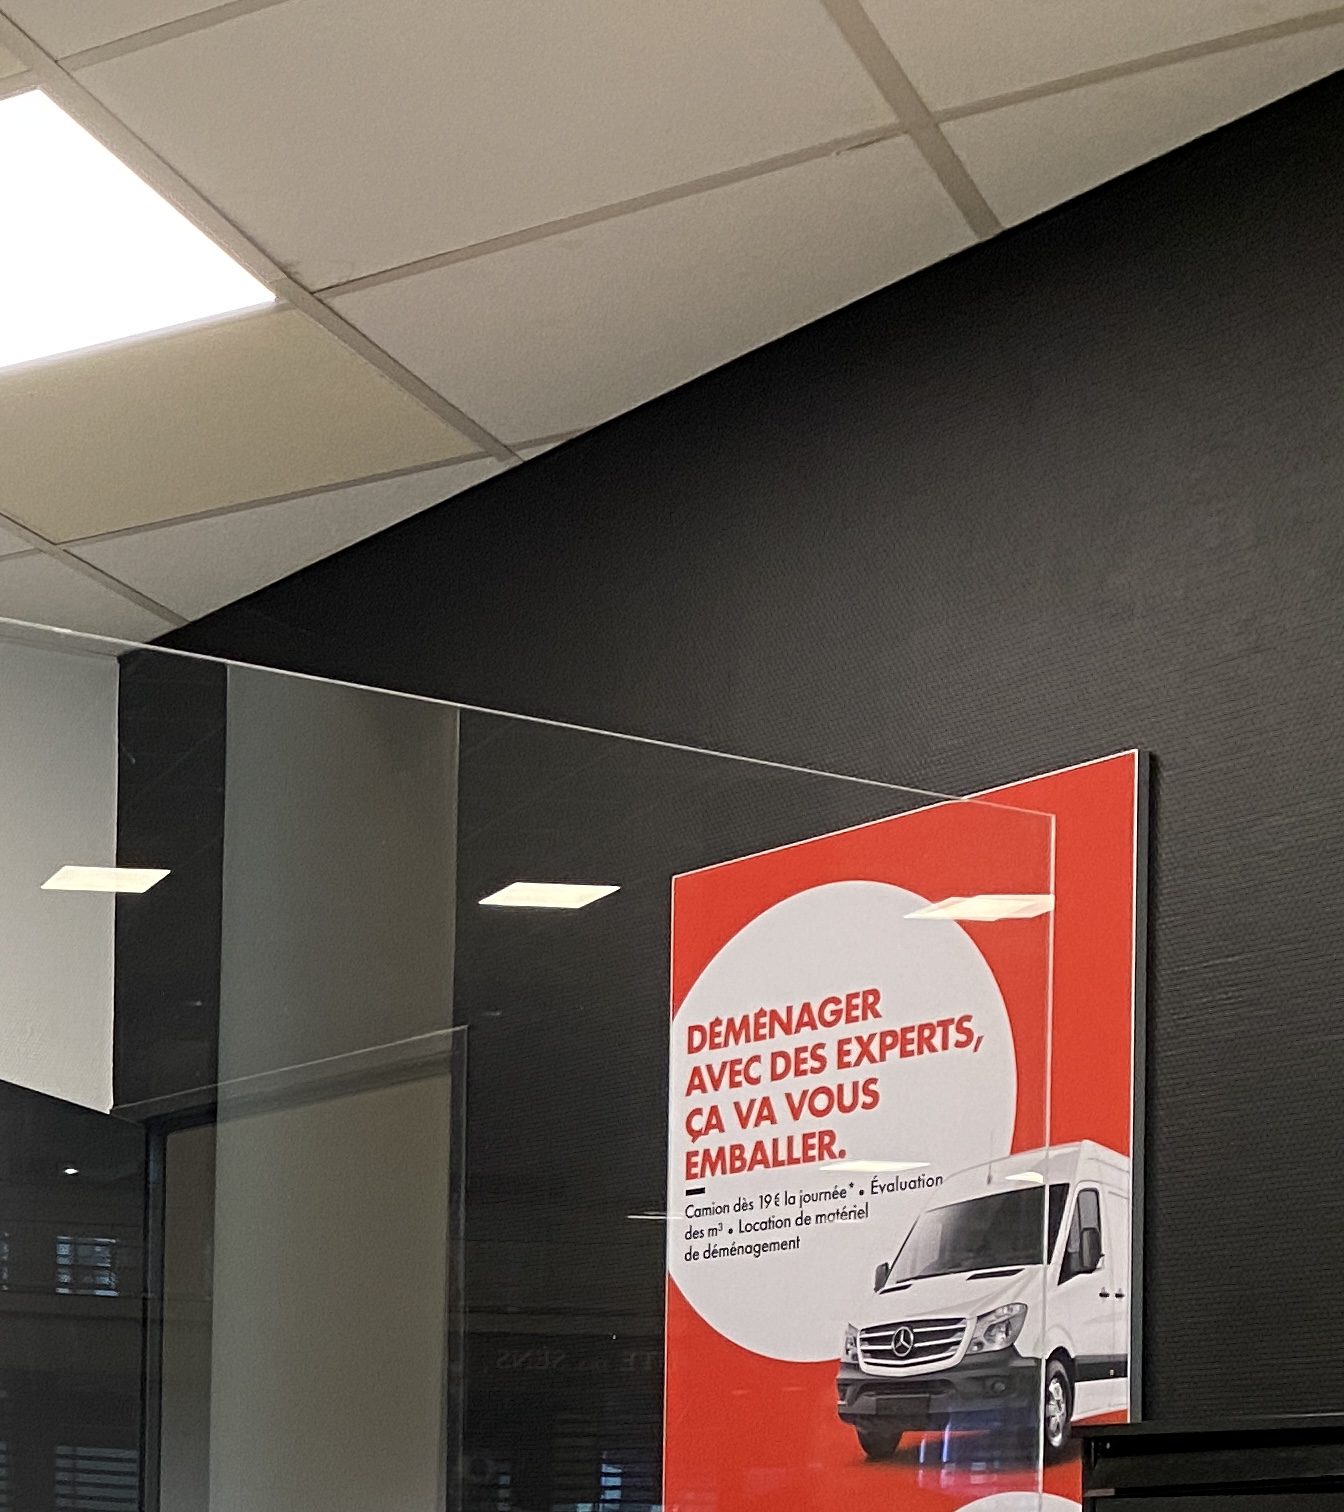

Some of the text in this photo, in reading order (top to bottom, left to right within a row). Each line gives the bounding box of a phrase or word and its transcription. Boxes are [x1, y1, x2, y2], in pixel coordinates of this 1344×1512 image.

[687, 988, 882, 1055] DÉMÉNAGER
[685, 1014, 984, 1097] AVEC DES EXPERTS,
[685, 1077, 880, 1144] ÇA VA VOUS
[685, 1129, 847, 1181] EMBALLER.
[685, 1174, 943, 1219] Camion dès la Évaluation
[685, 1224, 705, 1241] des
[739, 1215, 791, 1234] Location
[794, 1210, 811, 1226] de
[815, 1201, 869, 1225] matériel
[685, 1236, 801, 1262] de déménagement
